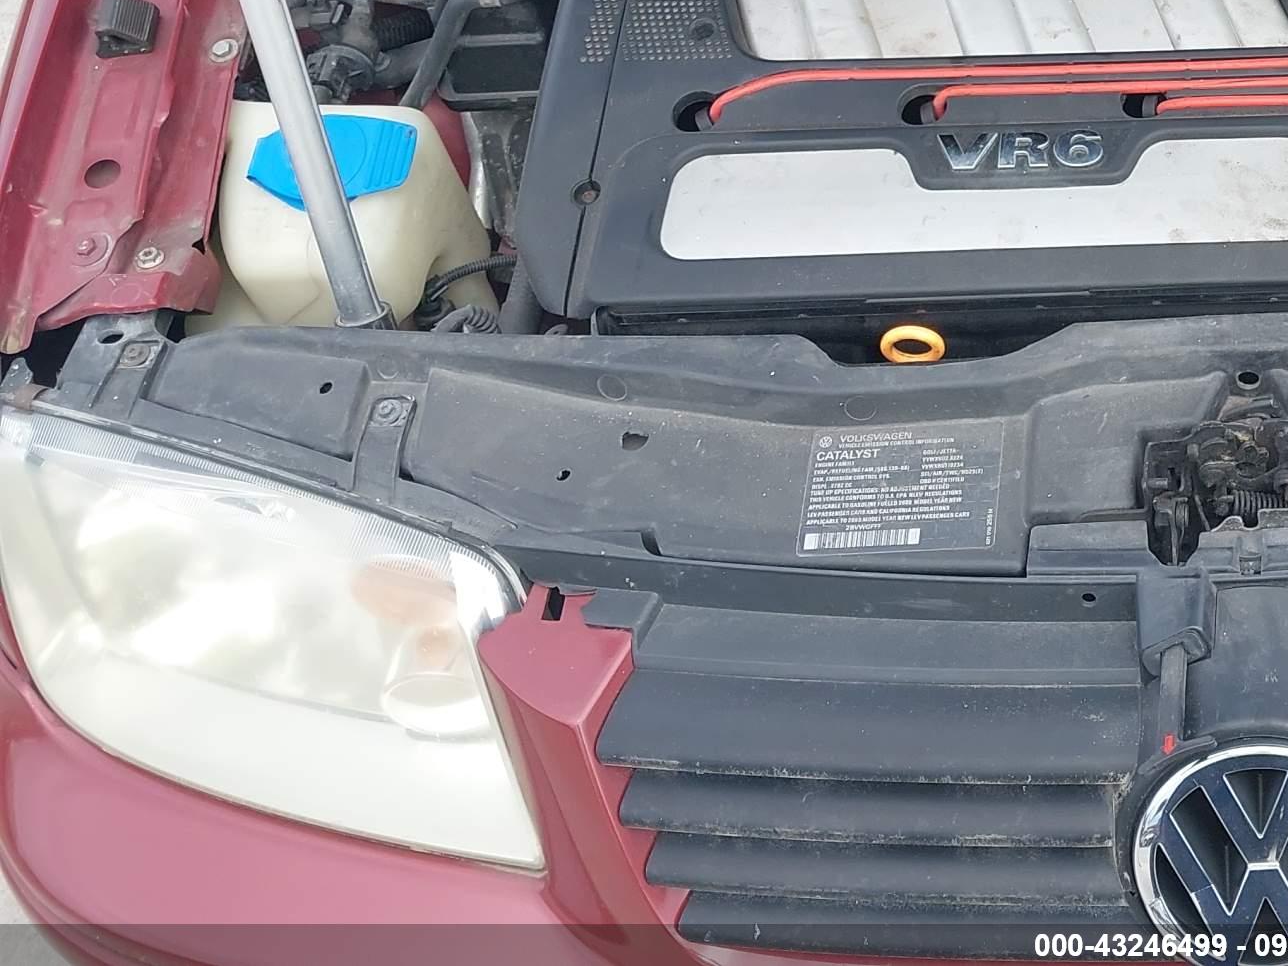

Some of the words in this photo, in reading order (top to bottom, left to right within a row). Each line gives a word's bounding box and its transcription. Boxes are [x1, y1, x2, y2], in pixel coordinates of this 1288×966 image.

[937, 129, 1103, 170] VR6
[840, 432, 912, 443] VOLKSWAGEN
[816, 448, 880, 461] CATALYST
[912, 505, 950, 513] REGULATIONS
